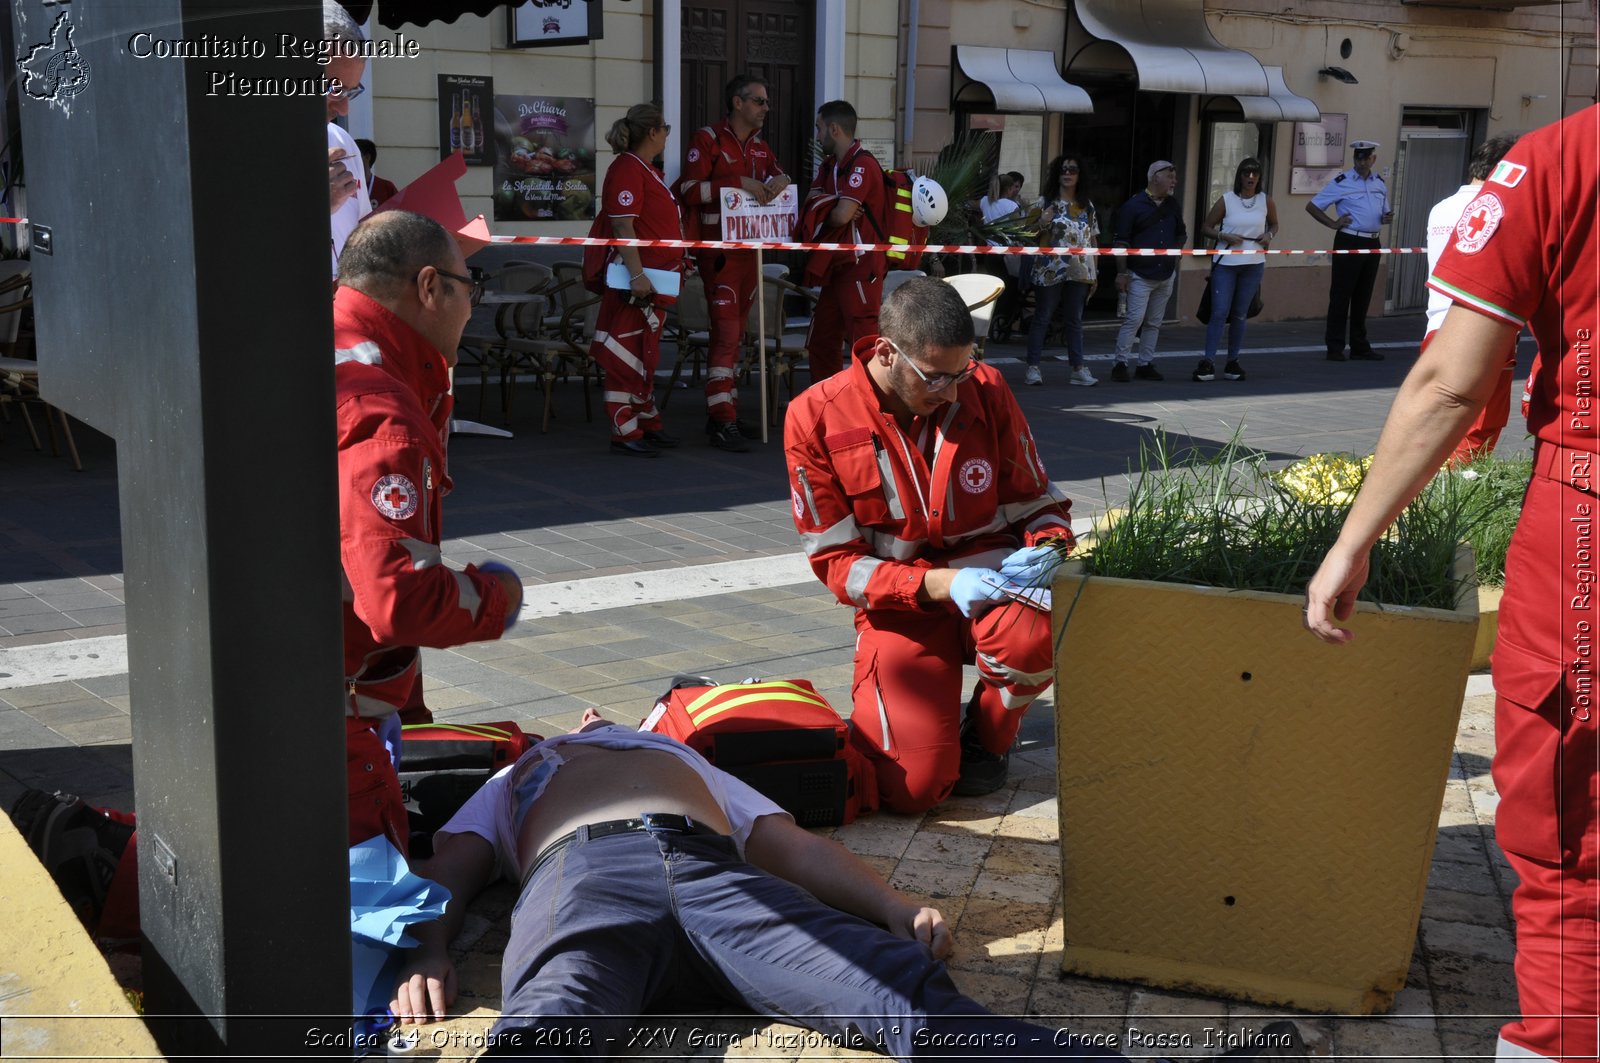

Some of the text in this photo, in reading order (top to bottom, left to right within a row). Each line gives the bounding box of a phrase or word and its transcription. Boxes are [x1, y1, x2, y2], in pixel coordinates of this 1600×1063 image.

[518, 100, 567, 117] DeChiara
[1298, 131, 1343, 146] Bimbi Belli
[513, 180, 554, 193] Sfogliatella
[555, 180, 564, 190] di
[564, 180, 588, 190] Scalea
[726, 213, 795, 240] PIEMONTE
